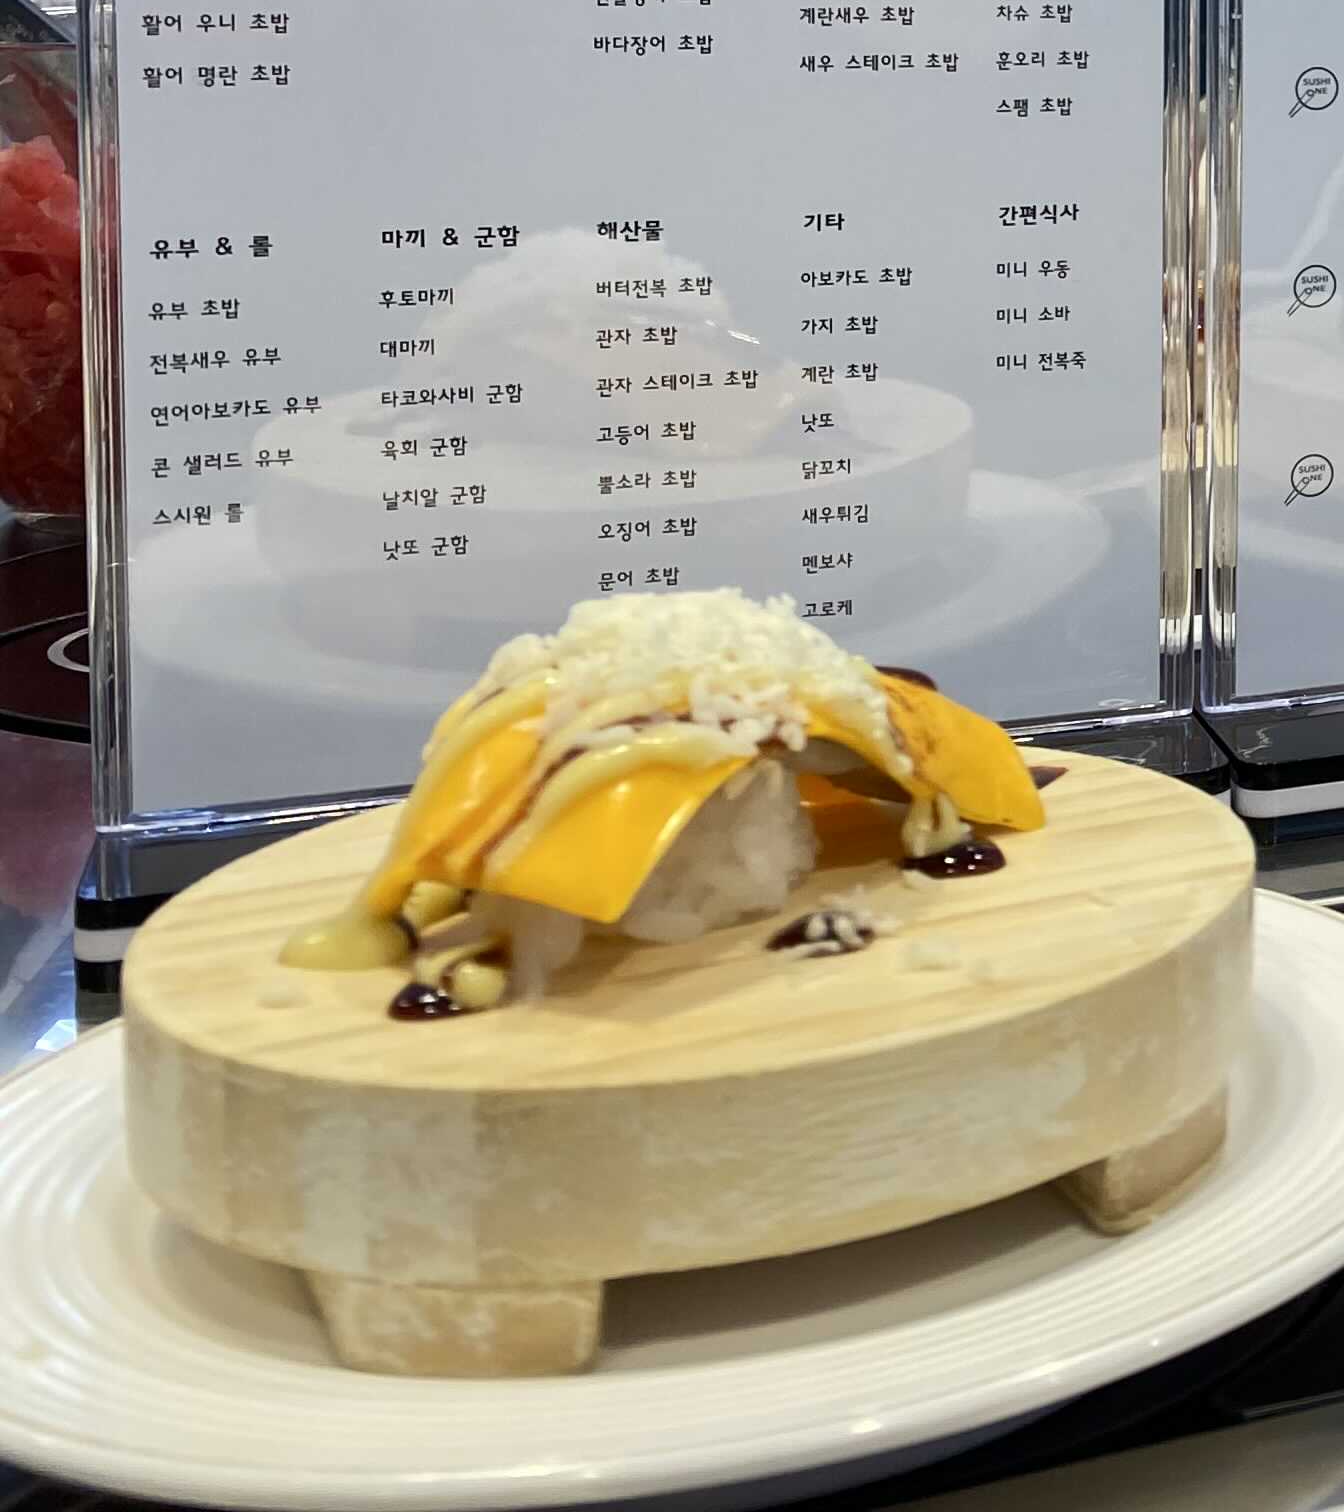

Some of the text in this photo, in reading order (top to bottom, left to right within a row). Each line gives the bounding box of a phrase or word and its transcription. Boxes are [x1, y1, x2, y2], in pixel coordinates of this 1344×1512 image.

[803, 212, 846, 232] 기타
[998, 203, 1080, 227] 간편식사
[381, 224, 521, 249] 마끼 & 군함
[596, 220, 665, 243] 해산물
[149, 238, 200, 260] 유부
[215, 236, 233, 256] &
[996, 259, 1071, 280] 미니 우동
[378, 287, 454, 310] 후토마끼
[596, 420, 697, 446] 고등어 초밥
[801, 503, 869, 525] 새우튀김
[800, 599, 853, 618] 고로케
